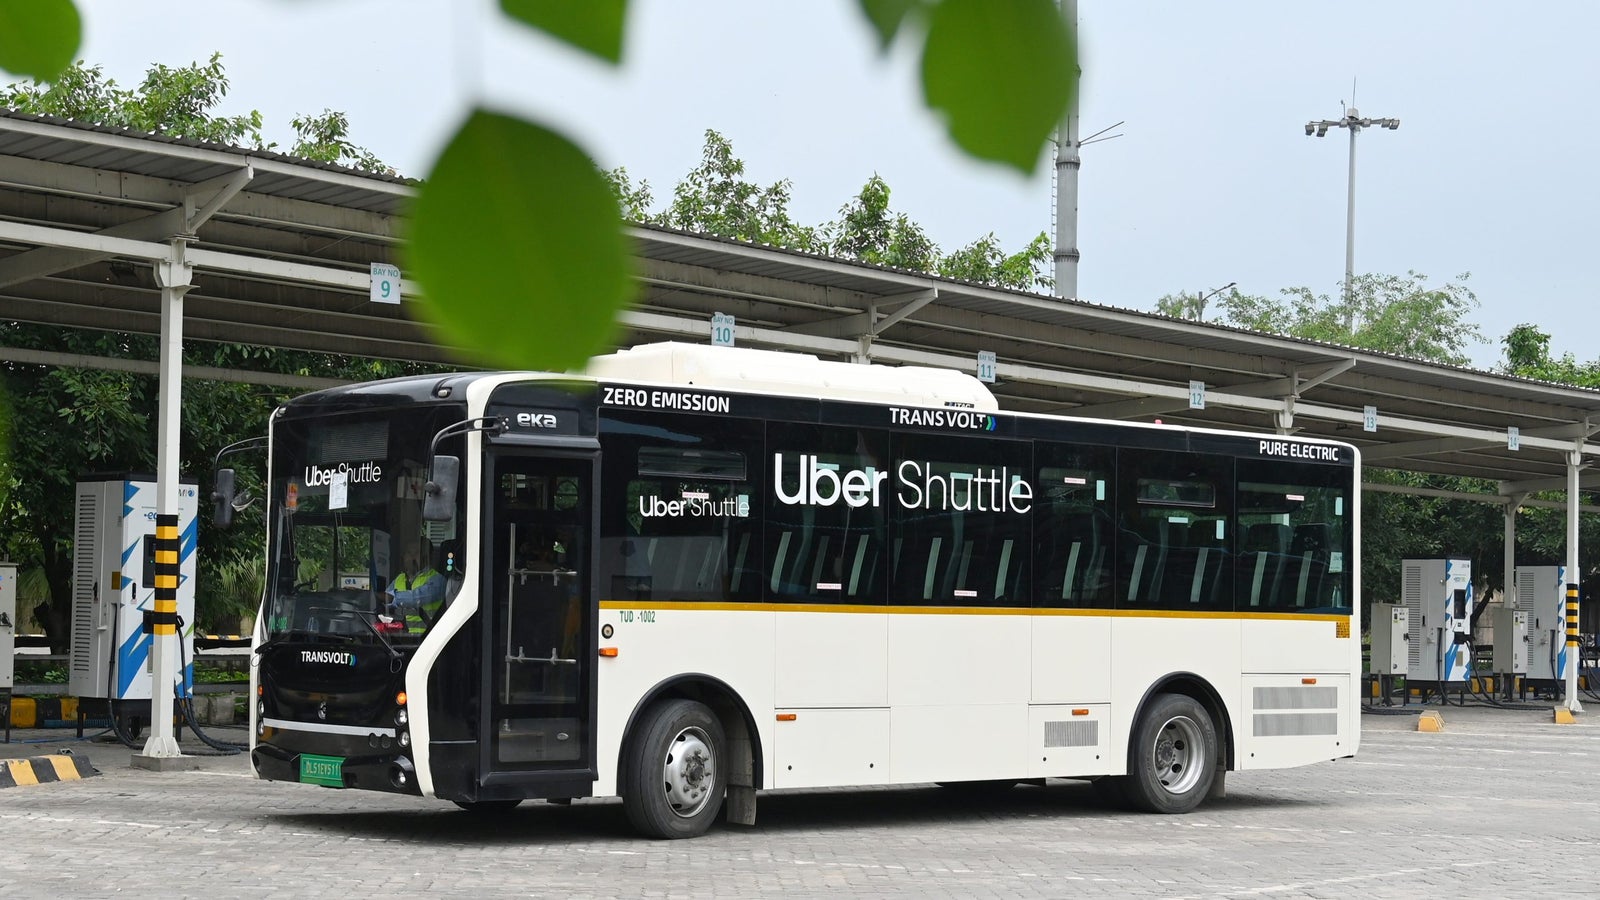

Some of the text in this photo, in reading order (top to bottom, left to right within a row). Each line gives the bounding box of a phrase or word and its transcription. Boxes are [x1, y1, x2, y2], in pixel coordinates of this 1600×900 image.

[373, 267, 399, 278] BAY NO
[381, 280, 390, 298] 9
[716, 327, 731, 343] 10
[981, 364, 993, 379] 11
[603, 387, 730, 413] ZERO EMISSION
[1192, 392, 1202, 406] 12
[516, 412, 557, 428] eka
[1366, 416, 1375, 429] 13
[1259, 440, 1339, 461] PURE ELECTRIC
[305, 460, 381, 487] Uber Shuttle
[774, 452, 1033, 514] Uber Shuttle
[639, 495, 750, 517] Uber Shuttle
[619, 610, 634, 623] TUD
[301, 651, 350, 665] TRANSVOLT
